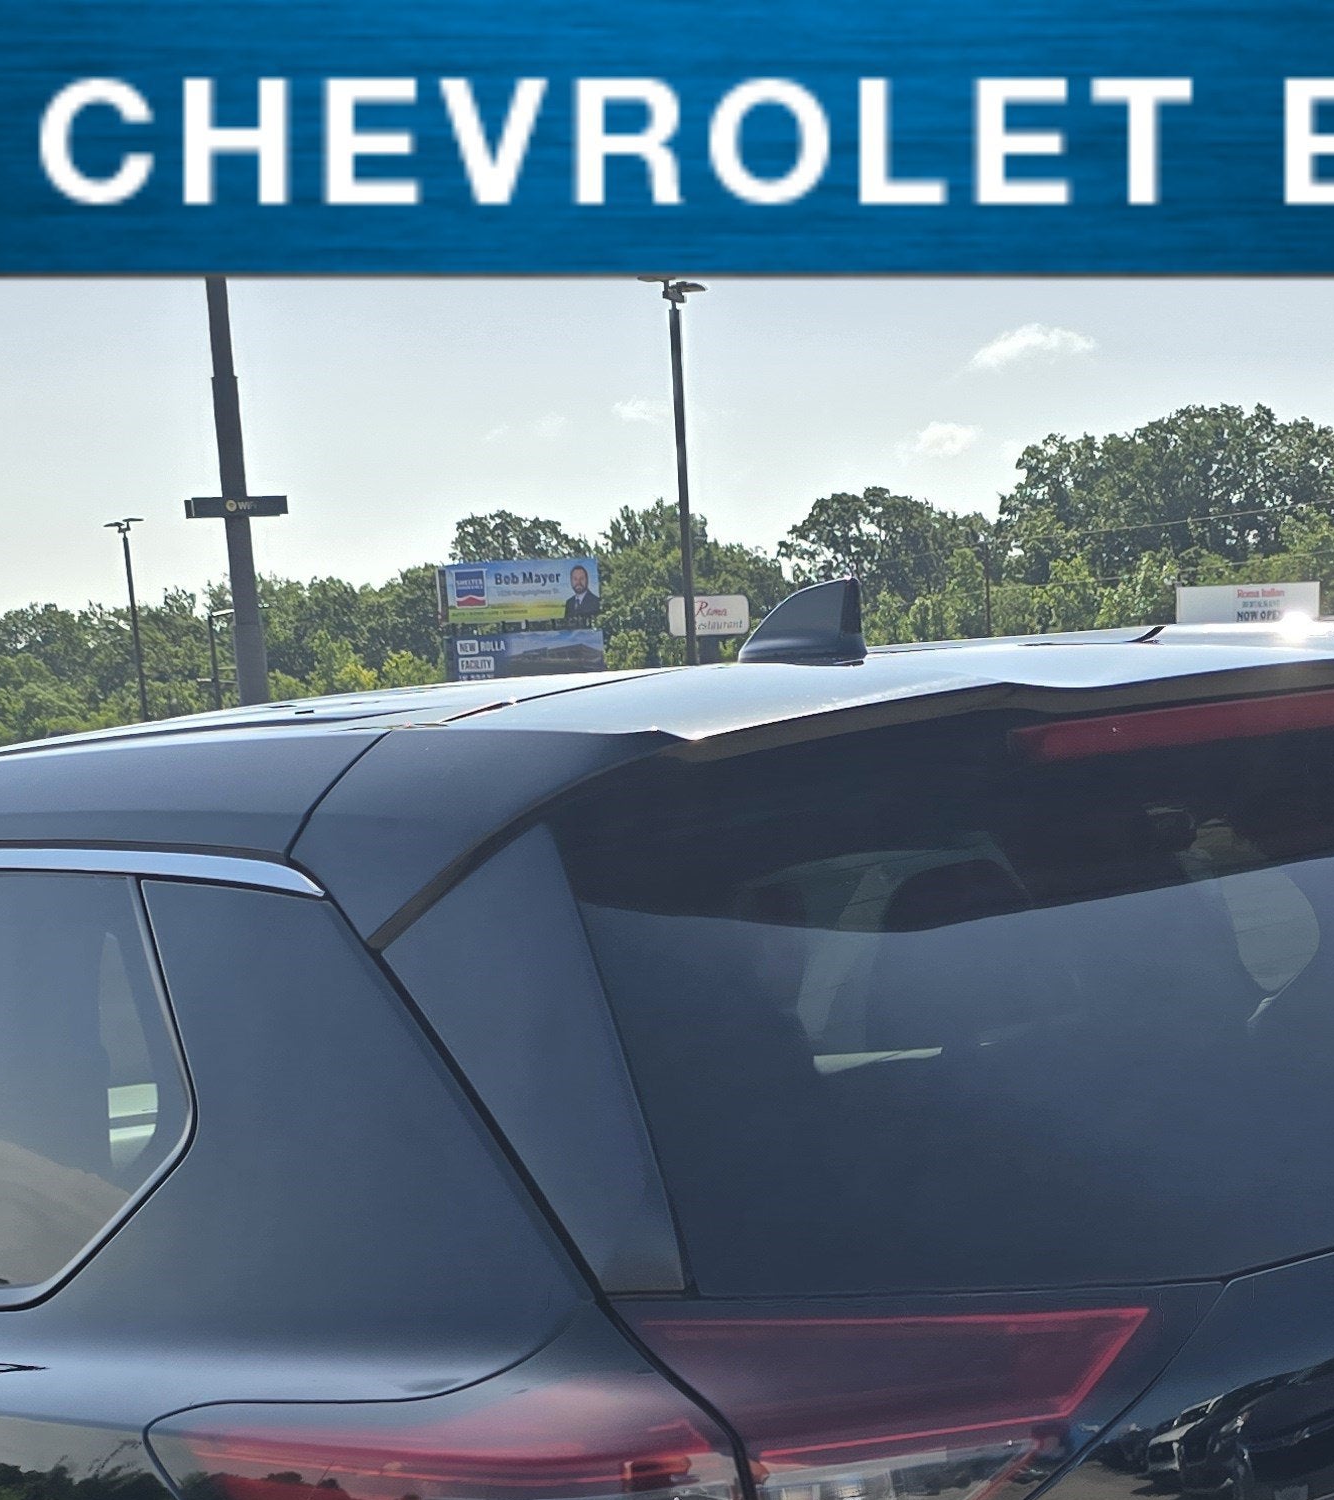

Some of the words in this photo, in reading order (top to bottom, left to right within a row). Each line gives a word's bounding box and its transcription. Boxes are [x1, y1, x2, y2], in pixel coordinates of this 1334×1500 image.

[495, 572, 519, 585] Bob
[522, 571, 561, 587] Mayer
[1236, 611, 1258, 622] NOW
[697, 620, 743, 630] estaurant
